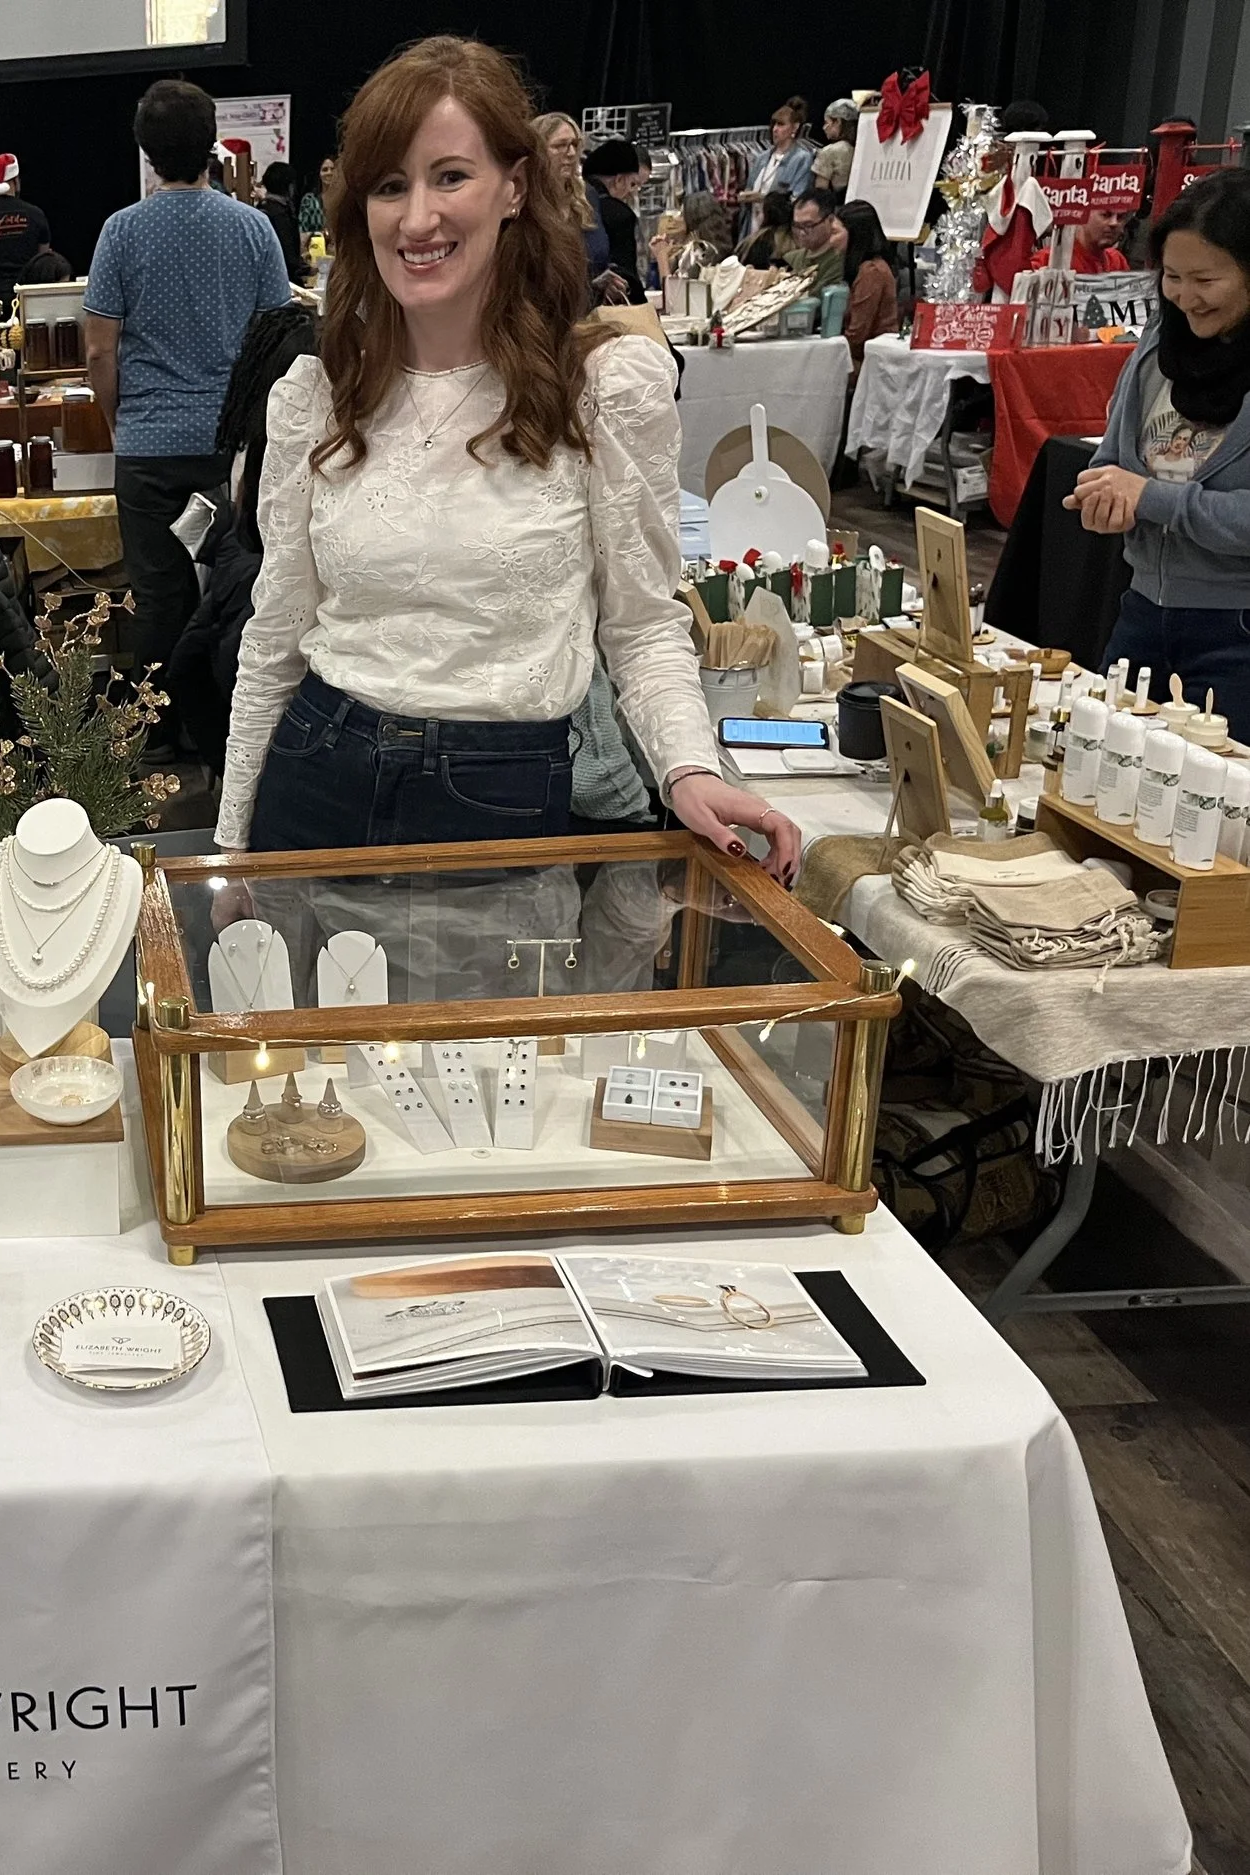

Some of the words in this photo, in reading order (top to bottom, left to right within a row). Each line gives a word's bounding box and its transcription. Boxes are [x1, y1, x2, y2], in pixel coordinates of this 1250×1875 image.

[1042, 185, 1089, 208] Santa
[75, 1344, 123, 1352] ELIZABETH
[126, 1346, 162, 1354] WRIGHT
